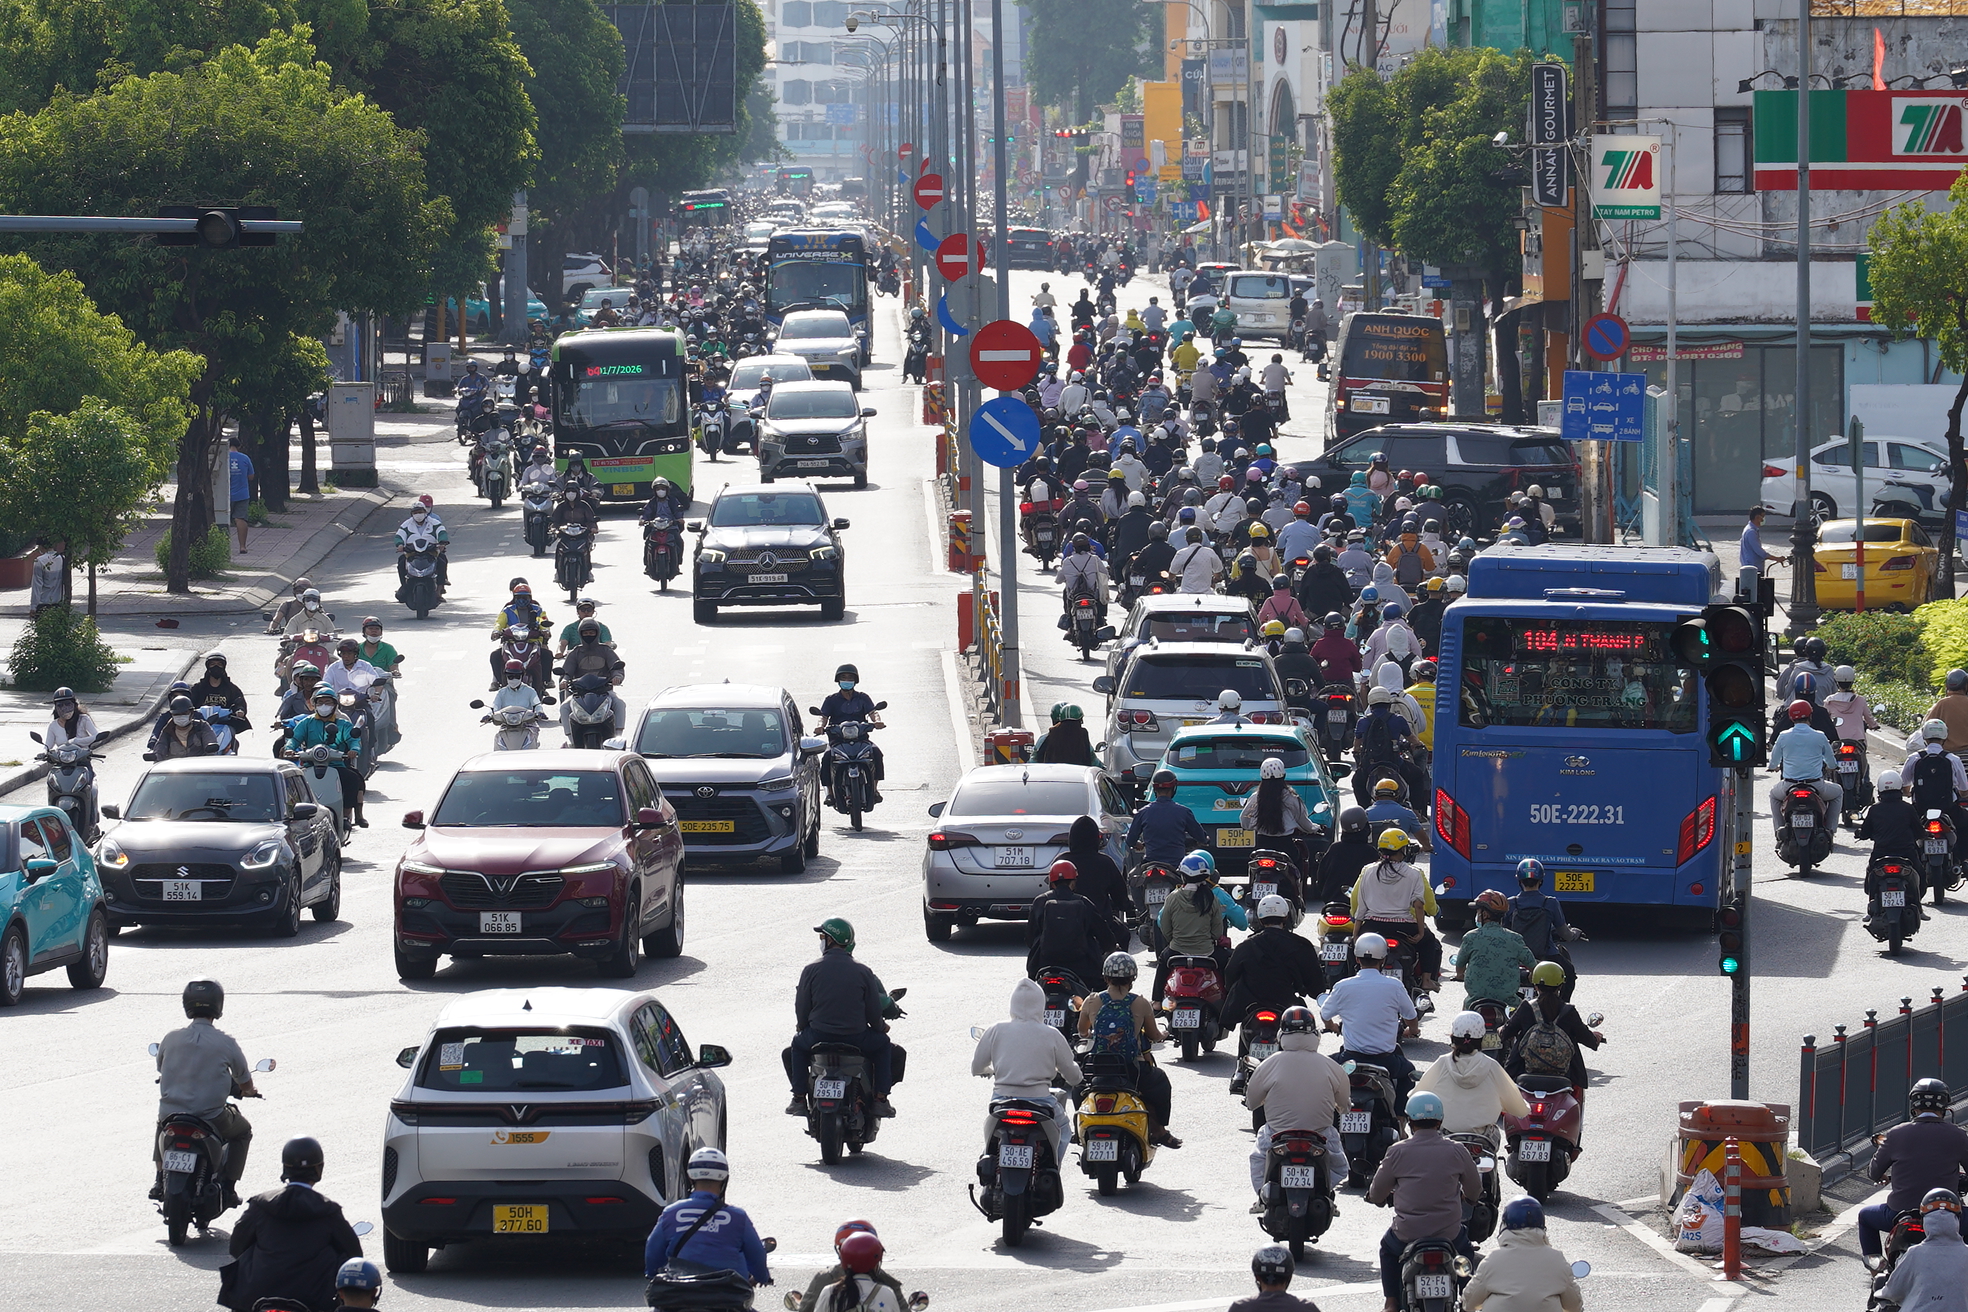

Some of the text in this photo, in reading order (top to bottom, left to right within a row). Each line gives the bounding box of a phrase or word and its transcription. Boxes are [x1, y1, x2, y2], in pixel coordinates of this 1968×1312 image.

[1544, 71, 1556, 141] GOURMET
[776, 251, 839, 259] UNIVERSE
[1364, 325, 1390, 334] ANH
[1364, 350, 1426, 362] 1900 3300
[1524, 629, 1558, 650] 104
[1551, 675, 1618, 689] CÔNG TY
[1523, 693, 1648, 708] PHƯƠNG TRANG
[1530, 803, 1625, 825] 50E-222.31
[682, 821, 730, 830] 50E-235.75
[1228, 830, 1245, 838] 50H
[1221, 839, 1251, 847] 317.13
[1006, 847, 1024, 856] 51M
[1738, 843, 1744, 853] 2
[999, 856, 1030, 865] 707.18
[1565, 873, 1583, 882] 50E
[173, 882, 191, 891] 51K
[1559, 882, 1589, 891] 222.31
[166, 891, 198, 900] 559.14
[491, 913, 509, 922] 51K
[484, 923, 517, 932] 066.85
[1176, 1010, 1196, 1019] 50-AE
[585, 1039, 604, 1047] TAXI
[820, 1081, 841, 1090] 50-AE
[816, 1089, 842, 1098] 295.18
[1344, 1113, 1366, 1122] 59-P3
[1342, 1123, 1368, 1132] 231.19
[511, 1133, 534, 1143] 1555
[1092, 1141, 1113, 1150] 59-PA
[1524, 1141, 1546, 1150] 67-H1
[1005, 1147, 1027, 1157] 50-AE
[1089, 1151, 1115, 1160] 227.11
[1521, 1152, 1549, 1161] 567.83
[164, 1160, 192, 1170] 872.24
[1002, 1157, 1029, 1167] 456.59
[1286, 1167, 1310, 1177] 50-N2
[510, 1207, 533, 1219] 50H
[500, 1219, 543, 1232] 377.60
[1420, 1276, 1446, 1286] 52-F4
[1421, 1287, 1446, 1296] 6139
